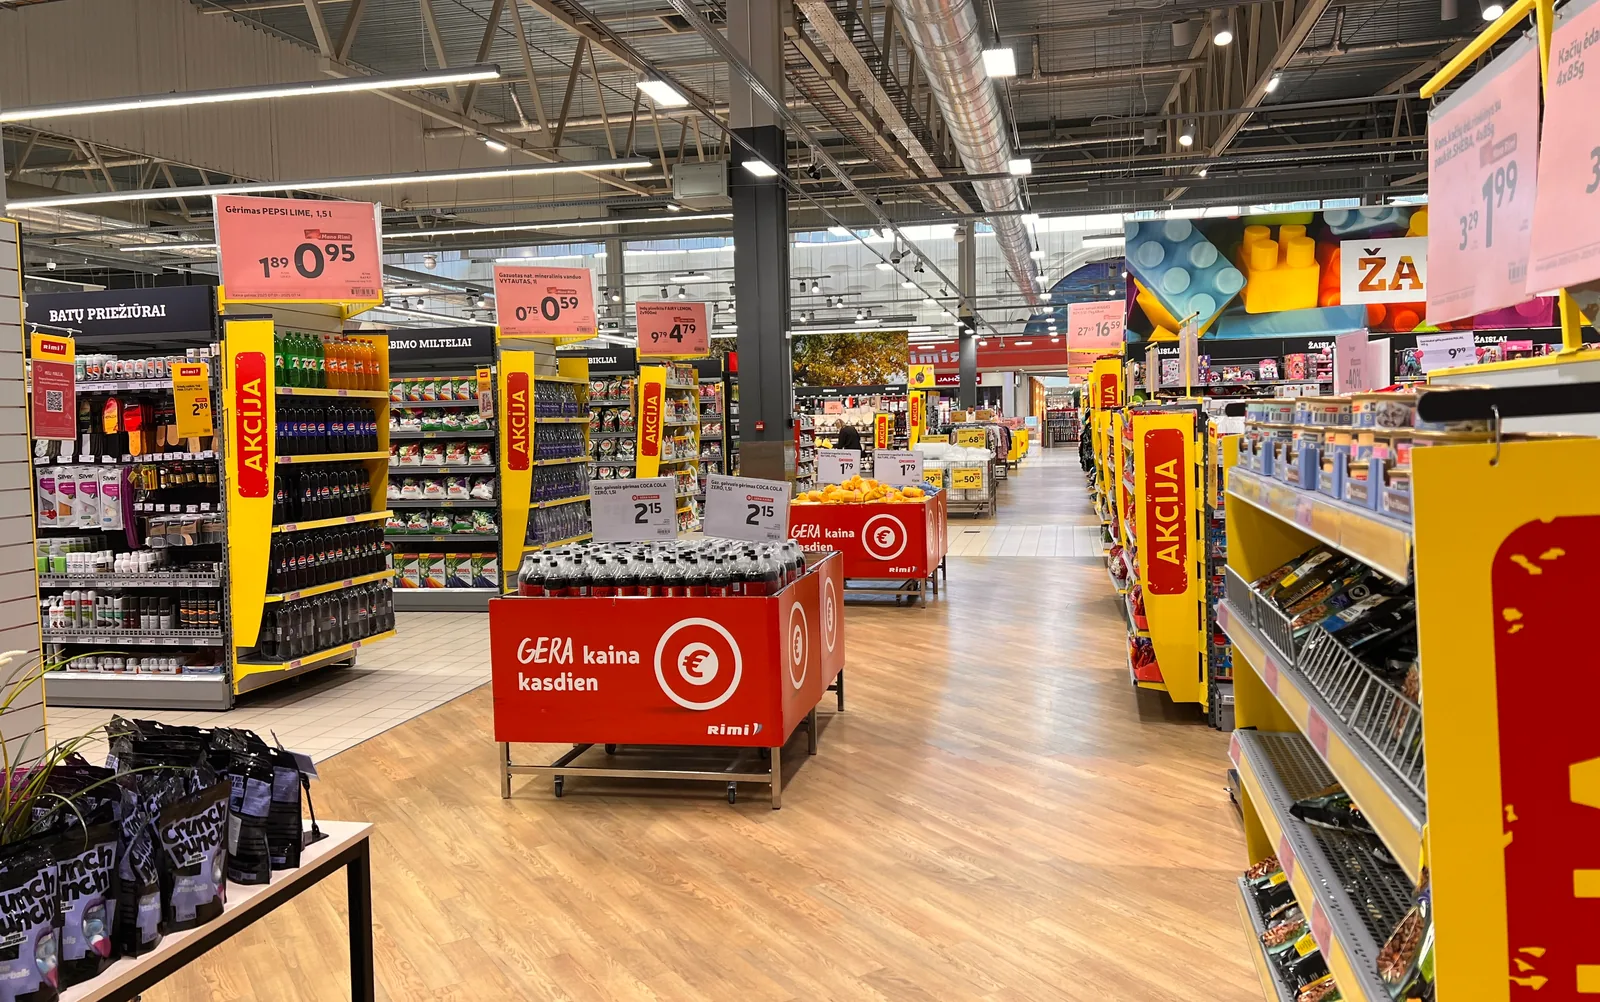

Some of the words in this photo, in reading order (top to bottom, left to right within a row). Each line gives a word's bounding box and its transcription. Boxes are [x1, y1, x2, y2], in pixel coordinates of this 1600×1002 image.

[1558, 38, 1582, 66] Kačių
[1556, 59, 1585, 87] 4x85g
[225, 205, 260, 215] Gėrimas
[290, 209, 313, 217] LIME,
[1358, 248, 1424, 292] ŽA
[49, 308, 84, 324] BATŲ
[88, 303, 166, 320] PRIEŽIŪRAI
[388, 340, 417, 349] BIMO
[420, 338, 472, 349] MILTELIAI
[243, 378, 263, 472] AKCIJA
[512, 390, 526, 453] AKCIJA
[646, 396, 658, 444] AKCIJA
[1155, 458, 1180, 565] AKCIJA
[791, 524, 821, 538] GERA
[825, 529, 854, 538] kaina
[798, 542, 833, 551] asdien
[516, 636, 575, 665] GERA
[583, 645, 640, 665] kaina
[518, 672, 598, 692] kasdien
